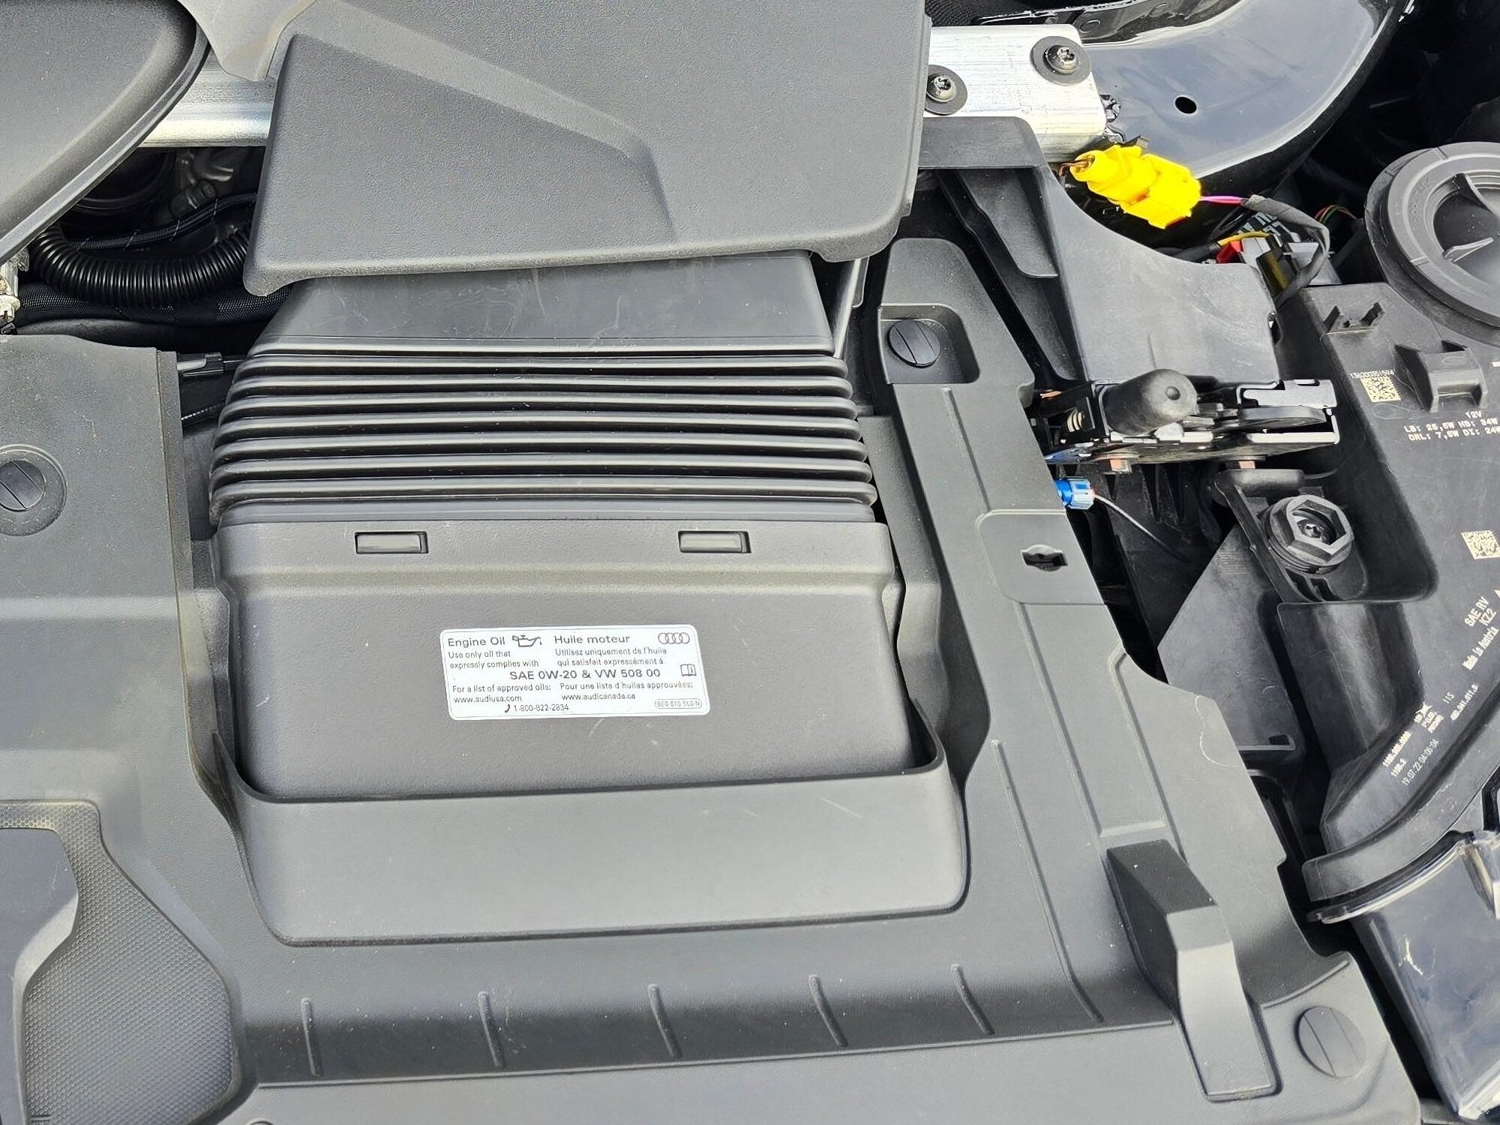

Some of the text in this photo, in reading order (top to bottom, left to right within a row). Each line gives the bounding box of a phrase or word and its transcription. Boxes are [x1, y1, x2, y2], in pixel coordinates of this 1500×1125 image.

[1464, 428, 1480, 436] DI:
[1464, 596, 1490, 627] SAE RV
[1479, 608, 1497, 626] KZ2
[448, 636, 506, 648] Engine Oil
[554, 635, 630, 644] Huile moteur
[1478, 626, 1499, 650] Austria
[448, 650, 511, 659] Use only oil that
[555, 648, 583, 656] Utilisez
[585, 648, 631, 657] uniquement
[632, 647, 642, 655] de
[450, 659, 540, 670] expressly complies with
[557, 658, 570, 667] qui
[571, 658, 602, 666] satisfait
[509, 668, 661, 680] SAE 0W-20 & VW 508 00
[452, 685, 465, 693] For
[473, 684, 485, 692] list
[487, 684, 495, 692] of
[497, 683, 533, 694] approved
[560, 682, 578, 690] Pour
[596, 682, 613, 690] liste
[453, 694, 522, 704] www.audiusa.com
[561, 692, 636, 701] www.audicanada.ca
[513, 703, 569, 712] 1-800-822-2834
